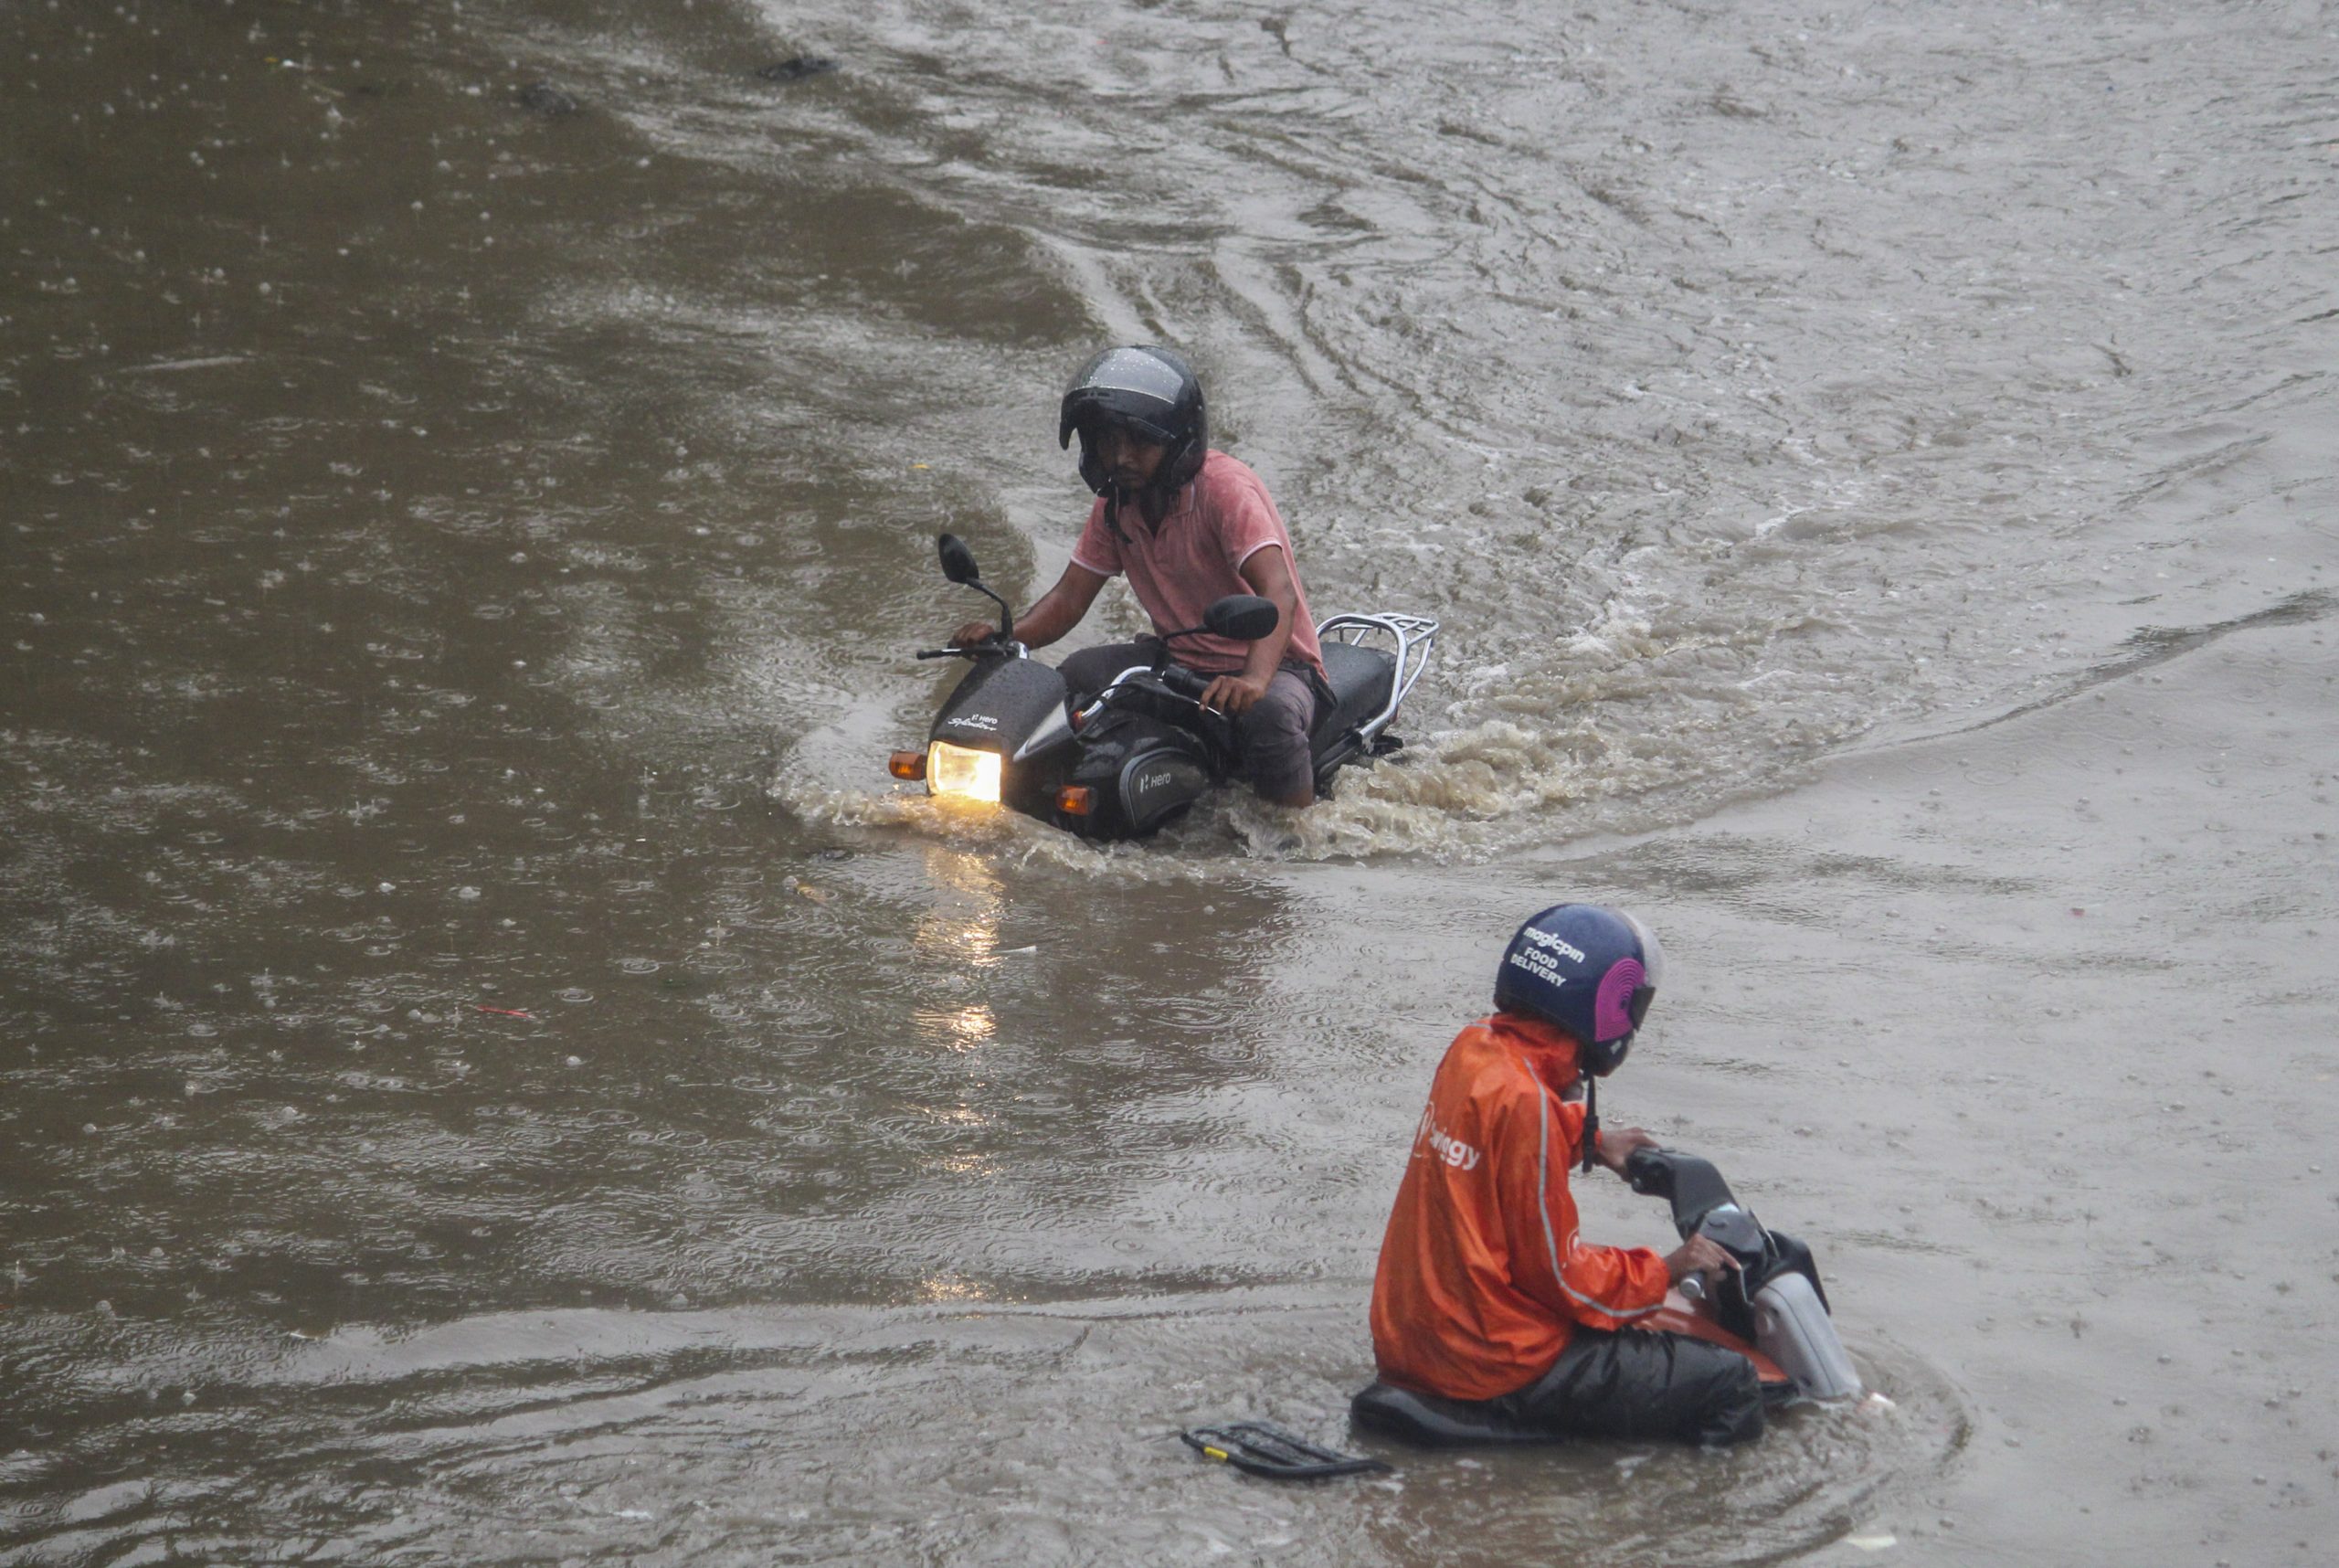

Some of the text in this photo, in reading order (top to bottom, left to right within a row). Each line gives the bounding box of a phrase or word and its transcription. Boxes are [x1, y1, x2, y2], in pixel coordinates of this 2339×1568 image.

[1150, 772, 1171, 788] Hero
[1523, 927, 1585, 964] magicpin
[1524, 947, 1559, 969] FOOD
[1510, 953, 1567, 987] DELIVERY
